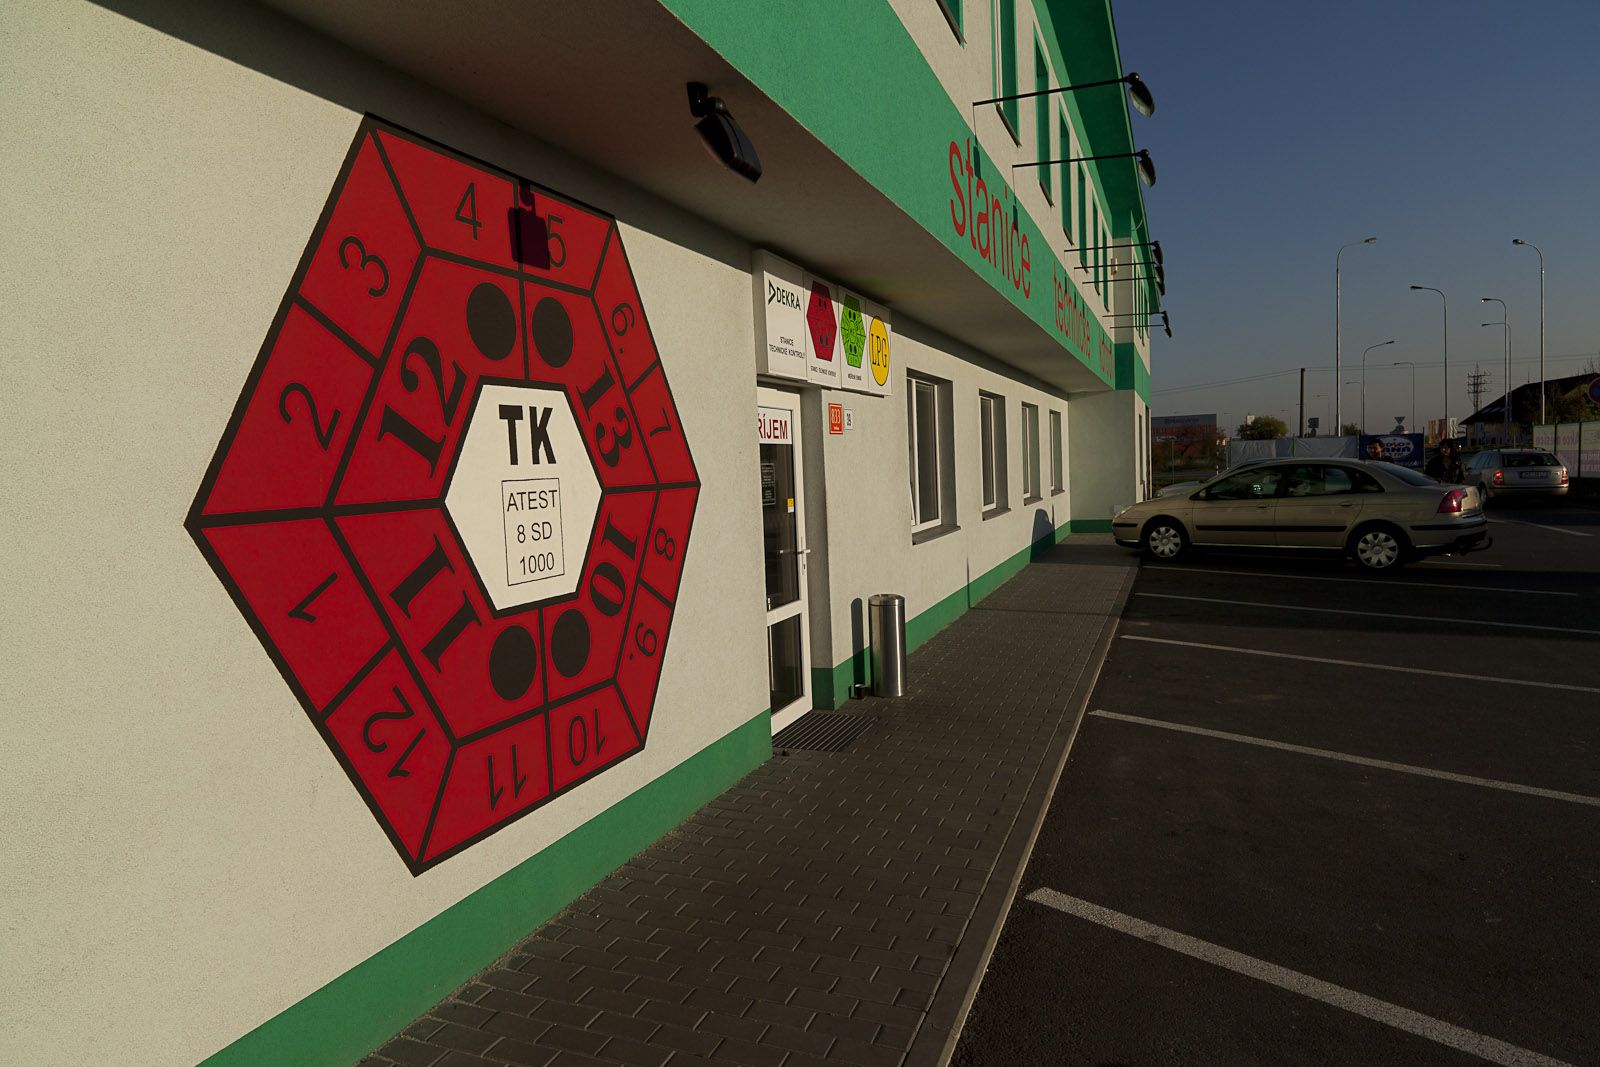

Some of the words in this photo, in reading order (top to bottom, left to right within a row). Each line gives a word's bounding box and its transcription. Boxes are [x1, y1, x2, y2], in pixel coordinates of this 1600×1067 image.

[455, 182, 483, 241] 4
[338, 236, 390, 298] 3
[545, 214, 567, 268] 5
[777, 286, 801, 311] DEKRA
[871, 333, 887, 367] LPG
[278, 382, 342, 452] 2
[377, 336, 470, 479] 12
[498, 404, 557, 465] TK
[576, 359, 633, 469] 13
[649, 407, 672, 438] 7
[757, 414, 788, 440] ŘÍJEM
[831, 408, 841, 425] 833
[507, 489, 558, 512] ATEST
[517, 524, 527, 544] 8
[531, 521, 553, 541] SD
[654, 527, 675, 561] 8
[519, 552, 555, 576] 1000
[590, 512, 638, 618] 10
[287, 571, 339, 624] 1
[389, 533, 484, 674] 11
[362, 684, 427, 779] 12
[568, 708, 607, 767] 10
[487, 744, 527, 812] 11
